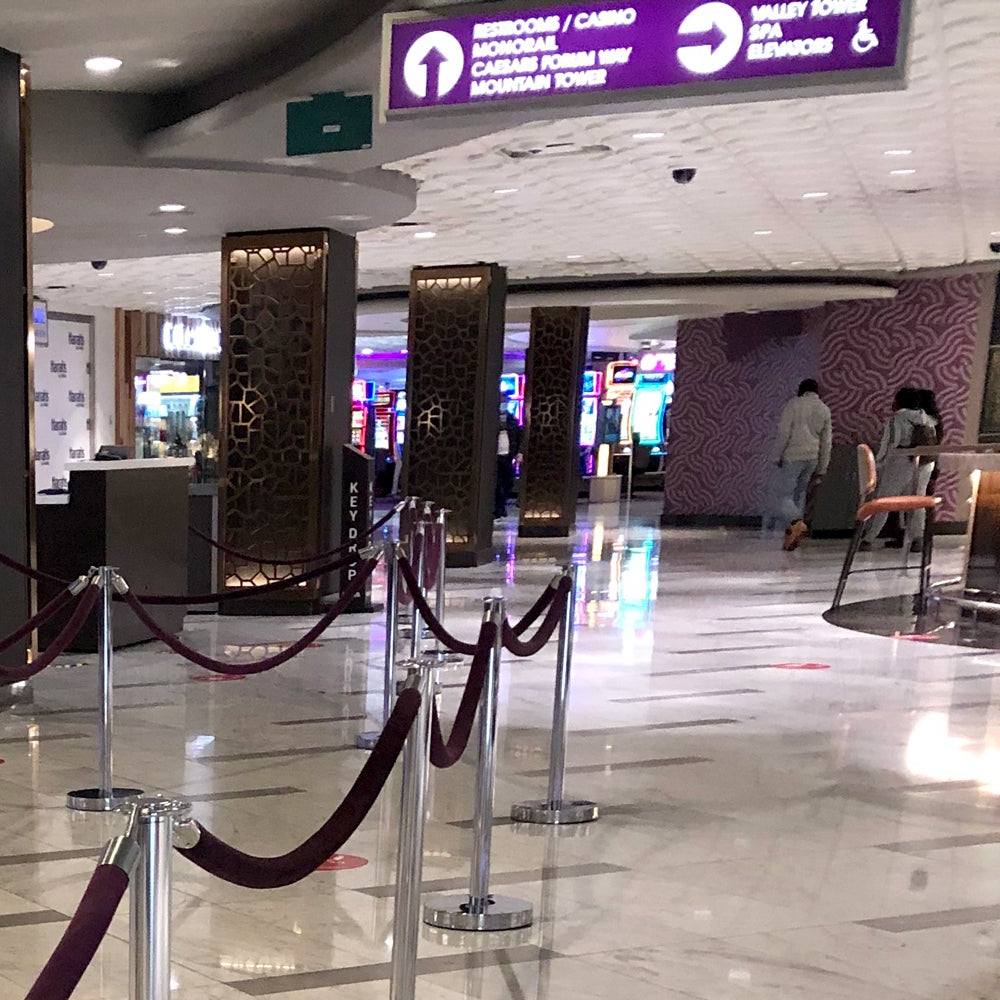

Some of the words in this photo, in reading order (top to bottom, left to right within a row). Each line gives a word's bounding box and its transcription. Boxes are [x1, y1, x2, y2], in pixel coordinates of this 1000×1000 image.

[473, 15, 560, 39] RESTROOMS
[574, 7, 637, 29] CASINO
[751, 1, 809, 21] VALLEY
[811, 0, 868, 16] TOWER
[748, 23, 783, 41] SPA
[472, 35, 558, 58] MONORAIL
[747, 37, 833, 60] ELEVATORS
[471, 56, 538, 77] CAESARS
[541, 50, 596, 71] FORUM
[598, 47, 632, 65] WAY
[470, 74, 551, 96] MOUNTAIN
[554, 68, 607, 88] TOWER
[349, 481, 359, 521] KEY
